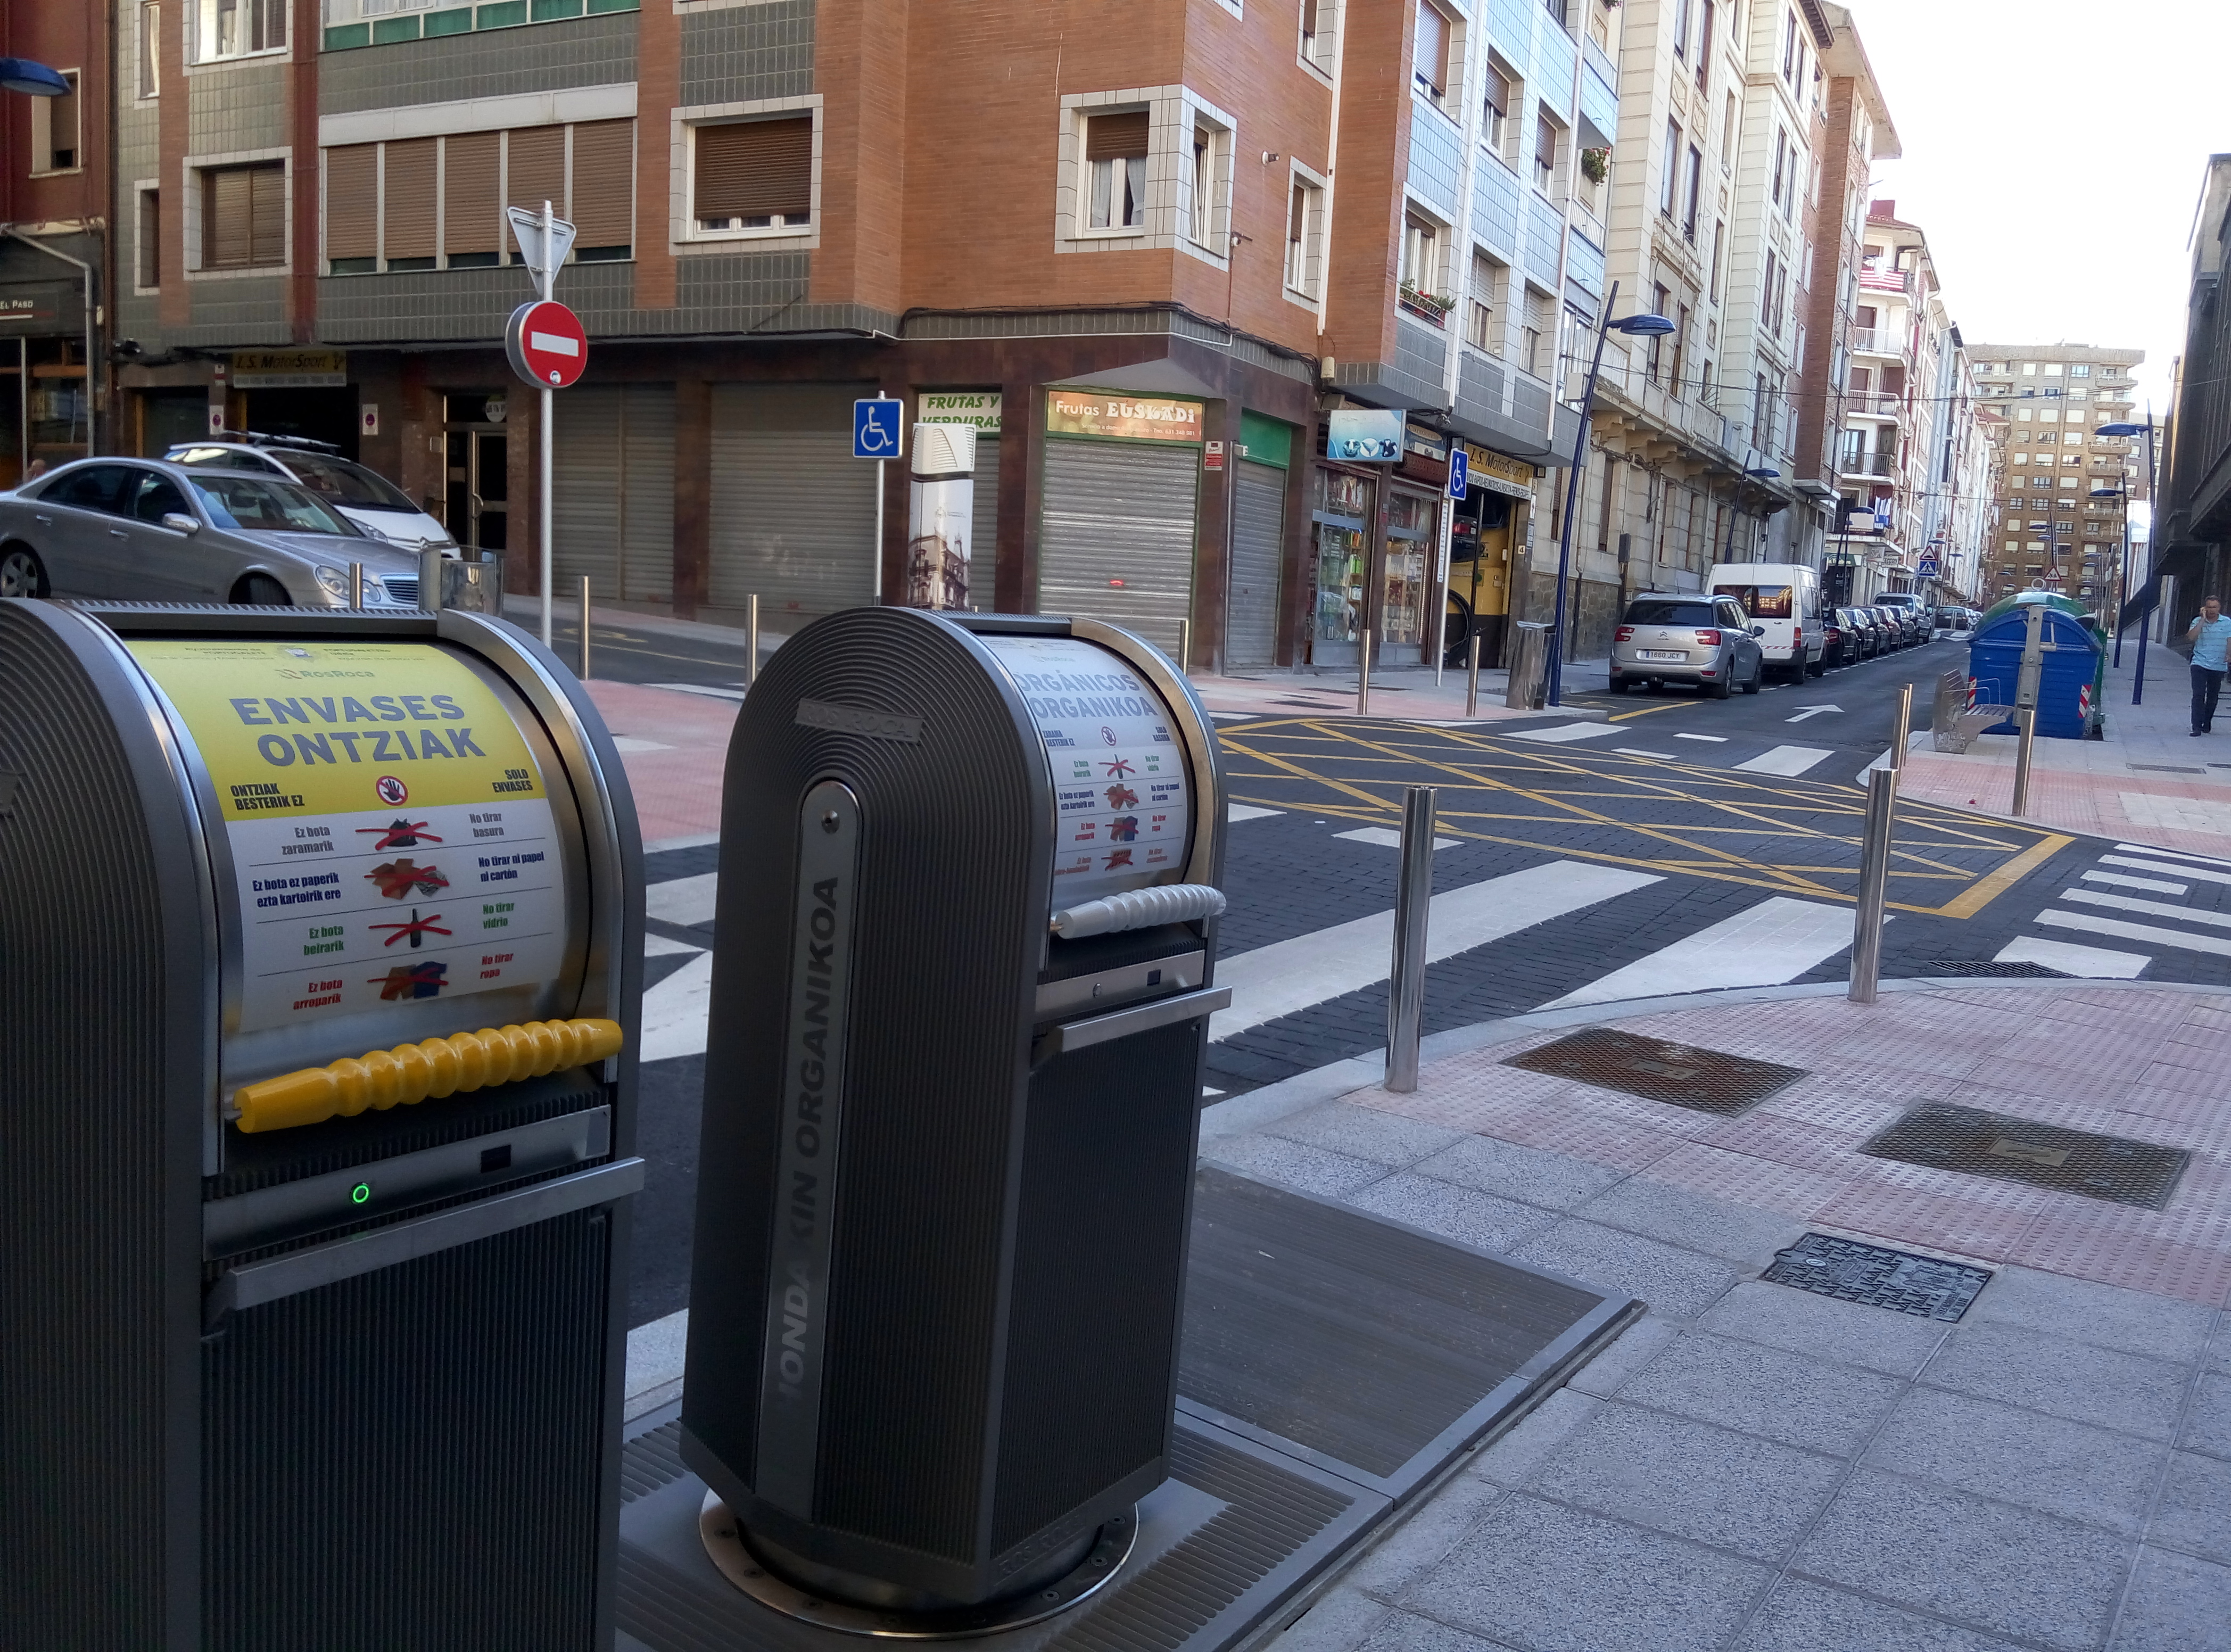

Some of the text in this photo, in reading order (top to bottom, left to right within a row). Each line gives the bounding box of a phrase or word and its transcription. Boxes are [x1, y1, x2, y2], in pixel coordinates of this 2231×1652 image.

[12, 300, 33, 309] PASO
[927, 395, 999, 409] FRUTAS Y
[1055, 400, 1100, 417] Frutas
[299, 670, 376, 679] RosRoca
[229, 695, 465, 725] ENVASES
[1028, 696, 1159, 719] ORGANIKOA
[846, 712, 914, 738] ROCA
[257, 728, 487, 767] ONTZIAK
[505, 769, 528, 780] SOLO
[230, 783, 280, 797] ONTZIAK
[492, 780, 533, 793] ENVASES
[235, 795, 305, 811] BESTERIK EZ
[469, 812, 502, 824] No tirar
[294, 826, 330, 838] Ez bota
[473, 827, 505, 838] basura
[282, 840, 335, 855] zaramarik
[478, 852, 545, 868] No tirar ni papel
[252, 872, 340, 891] Ez bota ez paperik
[480, 868, 518, 882] ni cartón
[257, 888, 342, 908] ezta kartoirik ere
[482, 902, 515, 915] No tirar
[483, 916, 508, 929] vidrio
[309, 926, 344, 939] Ez bota
[303, 940, 344, 956] beirarik
[481, 953, 514, 965] No tirar
[480, 968, 501, 979] ropa
[308, 979, 343, 993] Ez bota
[293, 993, 342, 1010] arroparik
[795, 875, 838, 1158] ORGANIKOA
